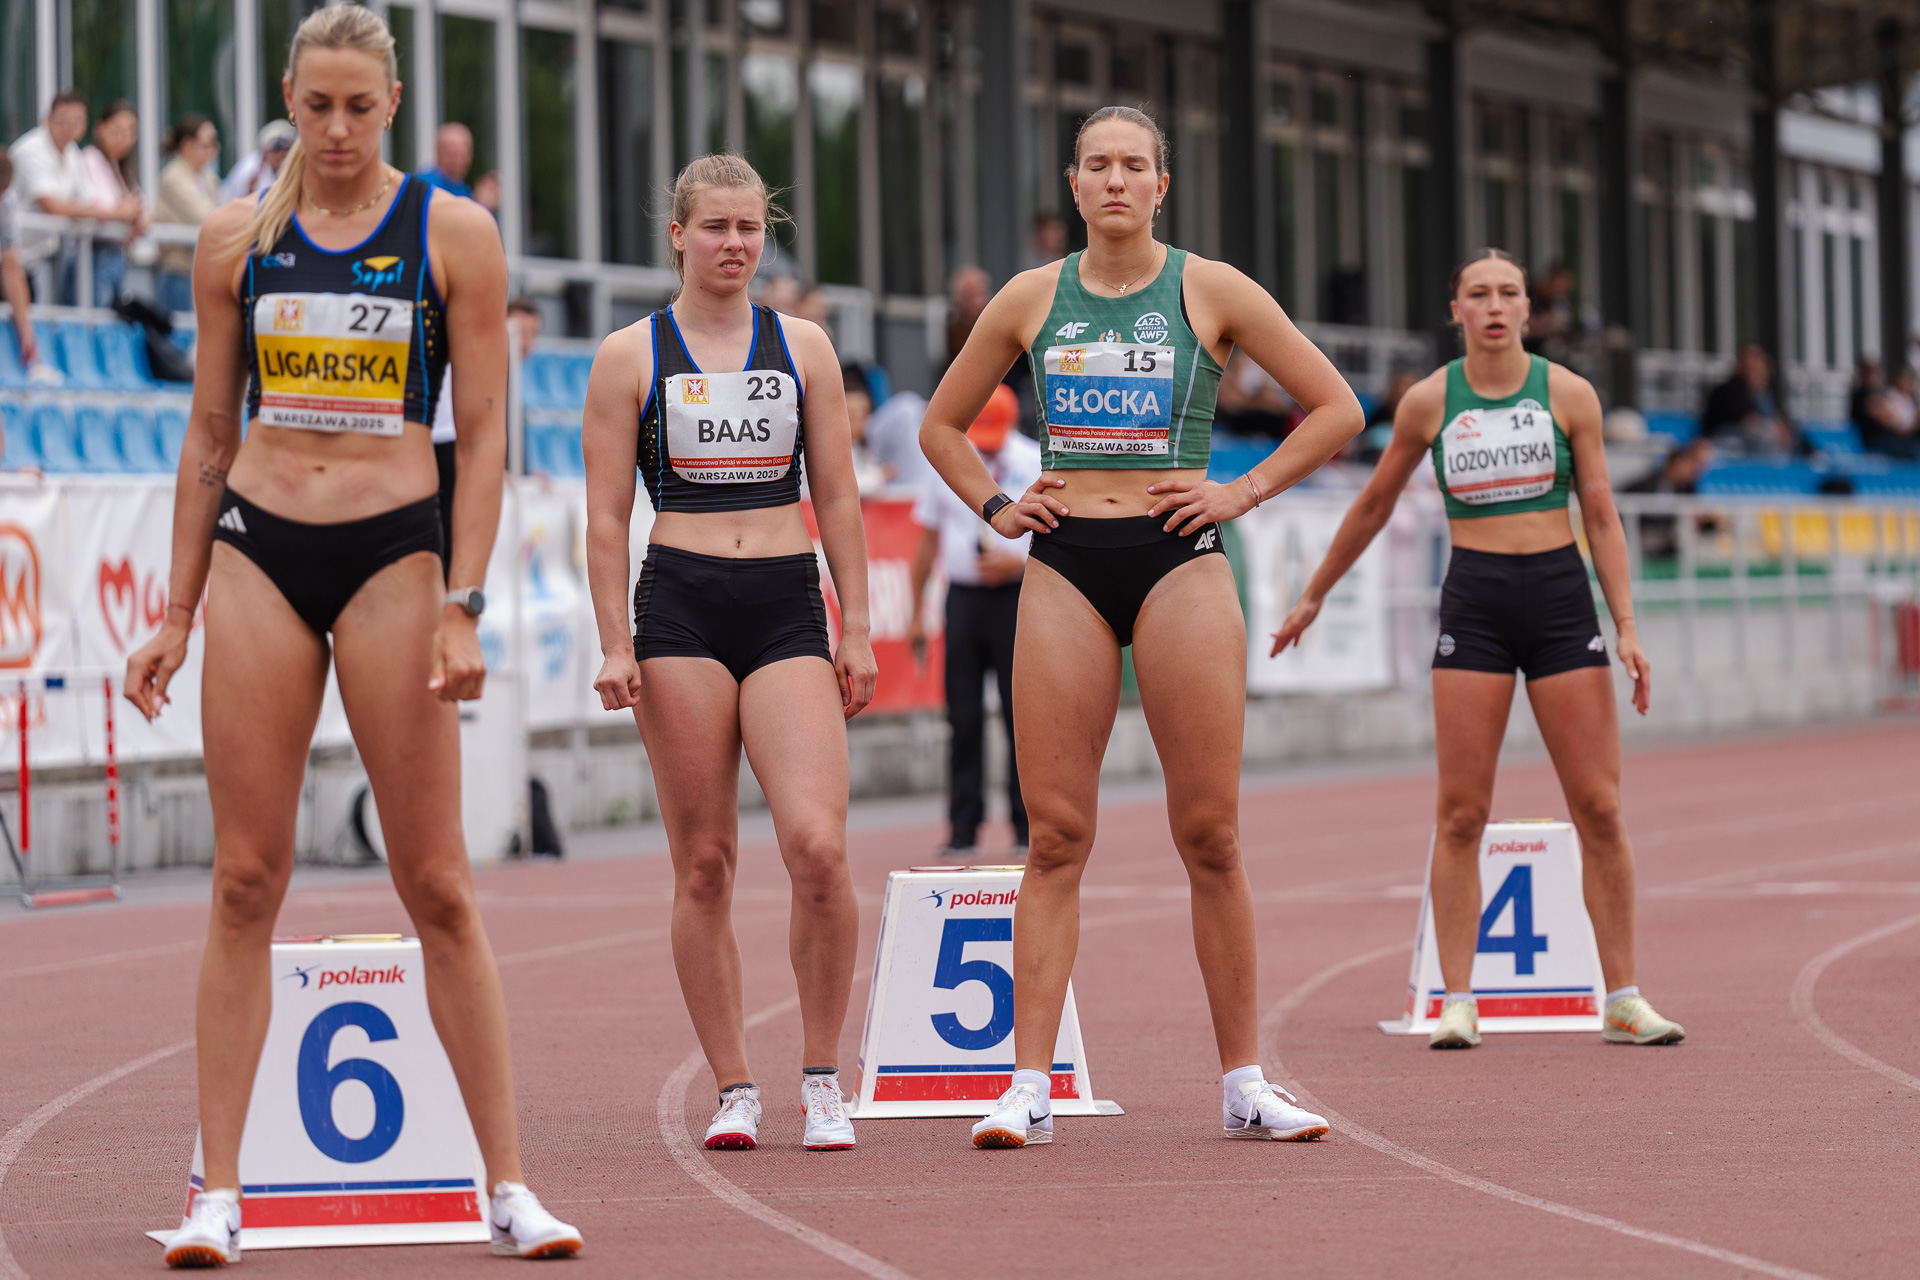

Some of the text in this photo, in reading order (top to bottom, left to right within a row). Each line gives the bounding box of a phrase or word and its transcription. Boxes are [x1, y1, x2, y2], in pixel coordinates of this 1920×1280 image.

[349, 304, 392, 333] 27
[1142, 317, 1161, 326] AZS
[1140, 330, 1163, 339] AWF
[264, 350, 399, 384] LIGARSKA
[1123, 350, 1156, 372] 15
[685, 395, 708, 403] PZLA
[747, 376, 781, 401] 23
[1055, 388, 1160, 415] SŁOCKA
[273, 411, 385, 429] WARSZAWA 2025
[698, 418, 771, 443] BAAS
[1510, 412, 1534, 430] 14
[1062, 440, 1154, 452] WARSZAWA 2025
[1449, 441, 1552, 473] LOZOVYTSKA
[687, 470, 779, 480] WARSZAWA 2025
[1487, 839, 1548, 856] polanik
[1476, 865, 1548, 975] 4
[319, 964, 406, 990] polanik
[930, 918, 1014, 1050] 5
[297, 1001, 404, 1163] 6
